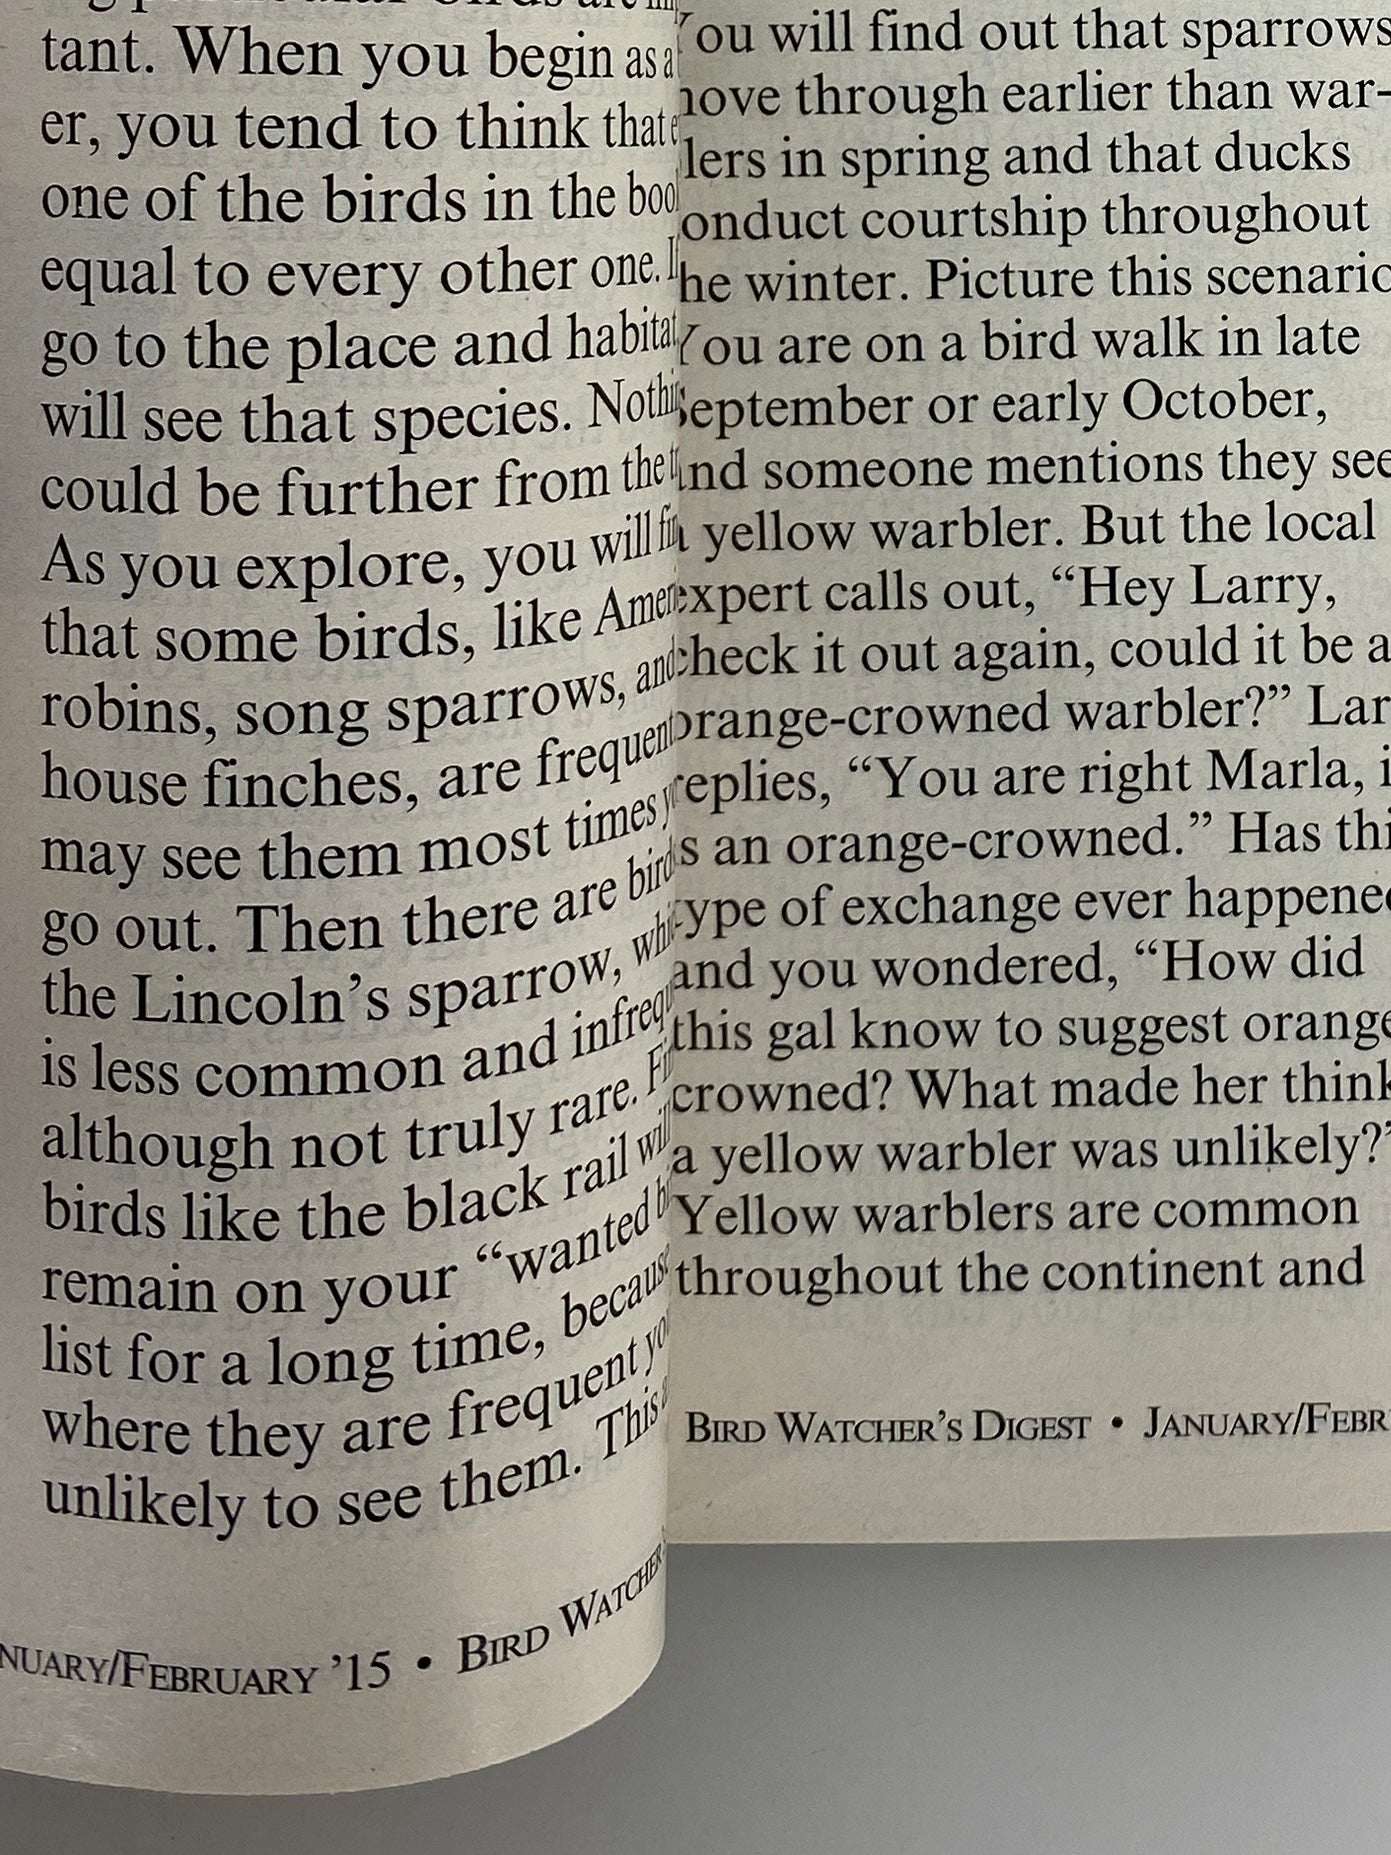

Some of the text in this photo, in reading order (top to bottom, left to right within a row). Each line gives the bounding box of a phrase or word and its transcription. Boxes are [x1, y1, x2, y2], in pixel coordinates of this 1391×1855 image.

[42, 171, 615, 223] one of the birds in the
[745, 259, 908, 302] winter.
[926, 257, 1093, 299] Picture
[1108, 254, 1191, 296] this
[41, 443, 664, 516] could be further from the
[994, 765, 1065, 796] are
[1080, 749, 1192, 804] right
[1207, 746, 1363, 797] Marla,
[42, 967, 116, 1019] the
[409, 947, 624, 1030] sparrow,
[668, 1069, 892, 1113] crowned?
[906, 1067, 1037, 1109] What
[1051, 1064, 1178, 1107] made
[1193, 1063, 1268, 1105] her
[42, 1131, 628, 1242] birds like the black rail
[671, 1190, 1359, 1235] Yellow warblers are common
[675, 1244, 1365, 1307] throughout the continent and
[42, 1386, 661, 1541] unlikely to see them. This
[0, 1643, 319, 1695] NUARY/FEBRUARY
[558, 1542, 664, 1638] WATCHER
